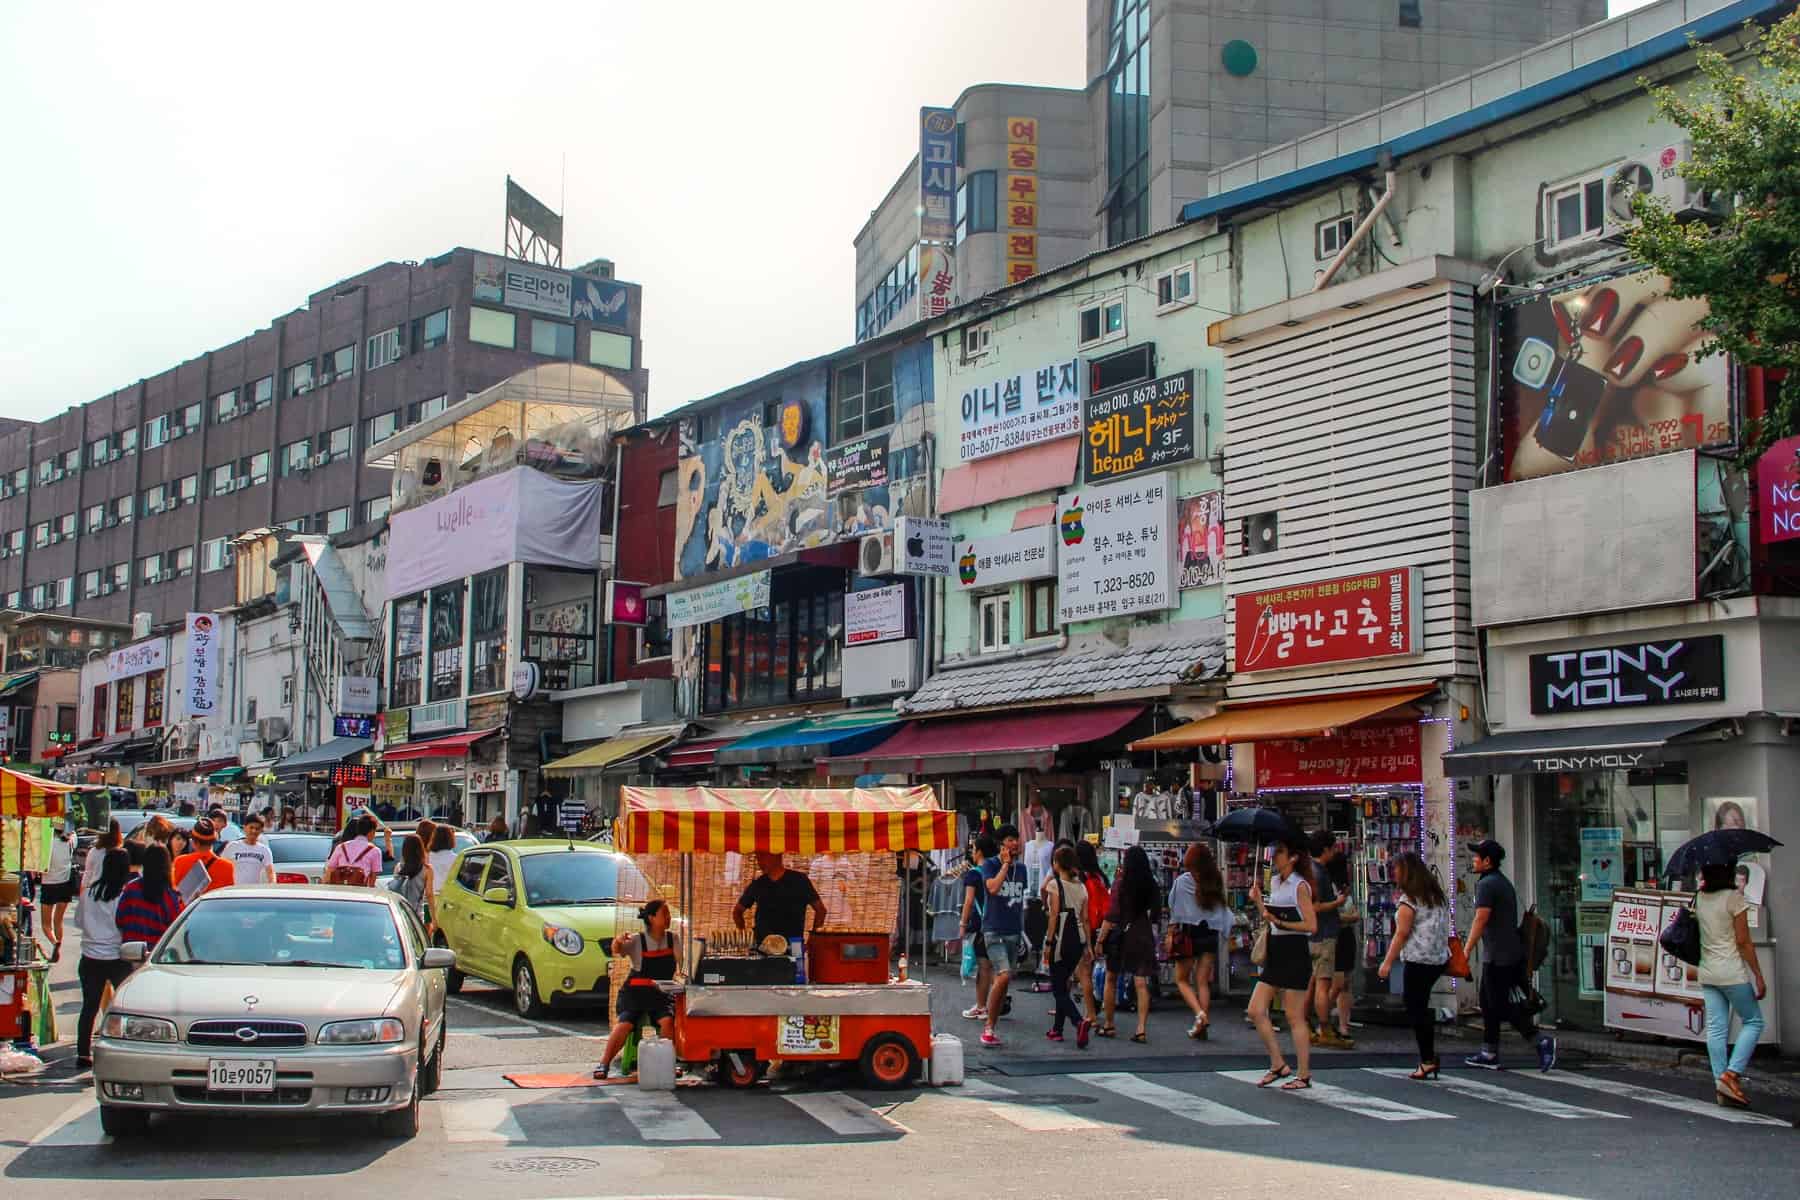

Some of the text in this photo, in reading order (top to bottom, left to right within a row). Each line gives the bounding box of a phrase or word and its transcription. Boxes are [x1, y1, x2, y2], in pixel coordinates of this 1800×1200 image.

[508, 273, 570, 300] 트릭아이
[962, 358, 1078, 422] 이니셜 반지
[1088, 402, 1152, 454] 헤나
[1162, 428, 1183, 446] 3F
[1092, 447, 1145, 474] henna
[1115, 491, 1142, 508] 서비스
[1145, 486, 1163, 504] 센터
[1141, 525, 1158, 541] 튜닝
[993, 552, 1021, 567] 악세사리
[1093, 571, 1155, 595] T.323-8520
[1390, 574, 1403, 649] 필름부착
[1547, 641, 1683, 679] TONY
[1547, 672, 1685, 708] MOLY
[1533, 753, 1643, 773] TONYMOLY
[1618, 906, 1647, 921] 스네일
